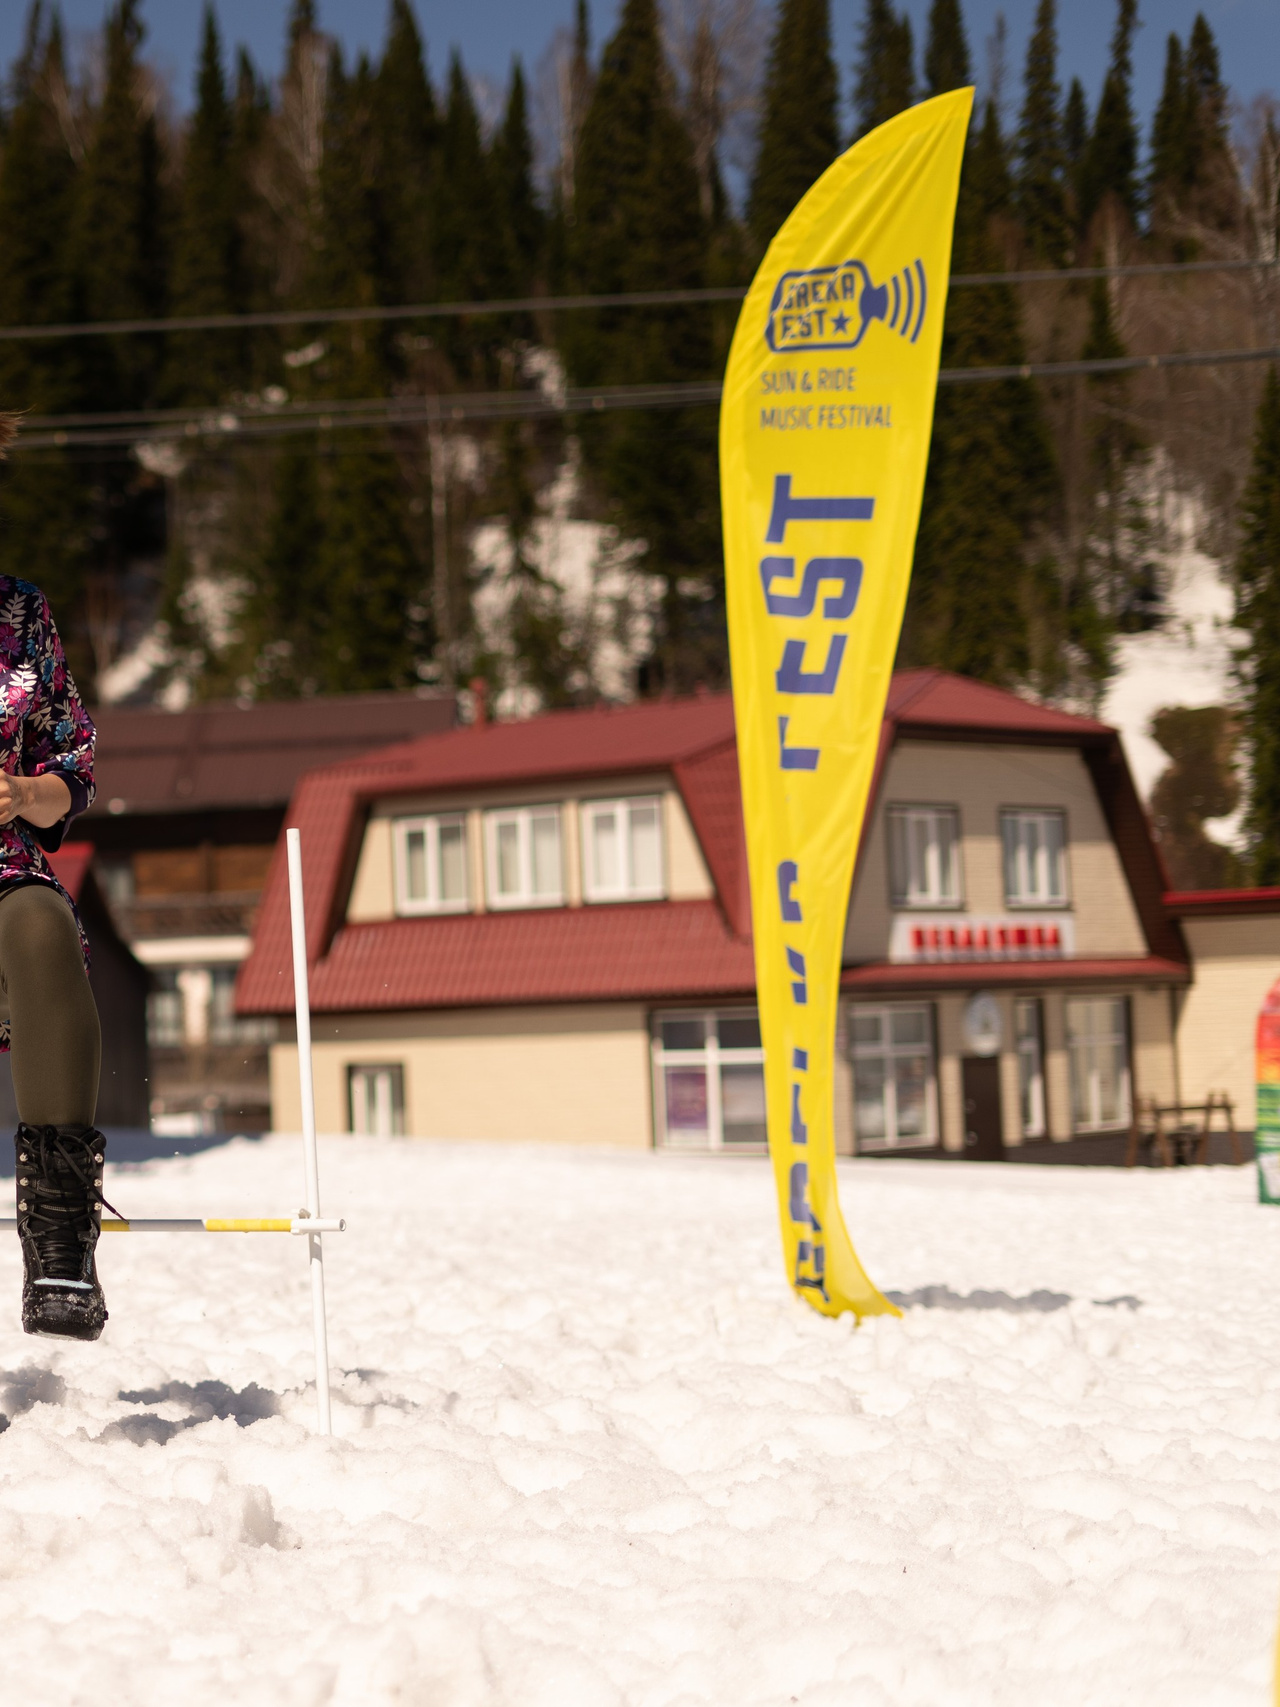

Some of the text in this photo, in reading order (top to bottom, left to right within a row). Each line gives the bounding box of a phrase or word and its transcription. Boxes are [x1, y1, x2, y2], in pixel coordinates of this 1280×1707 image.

[761, 366, 857, 395] SUN & RIDE
[760, 401, 892, 431] MUSIC FESTIVAL
